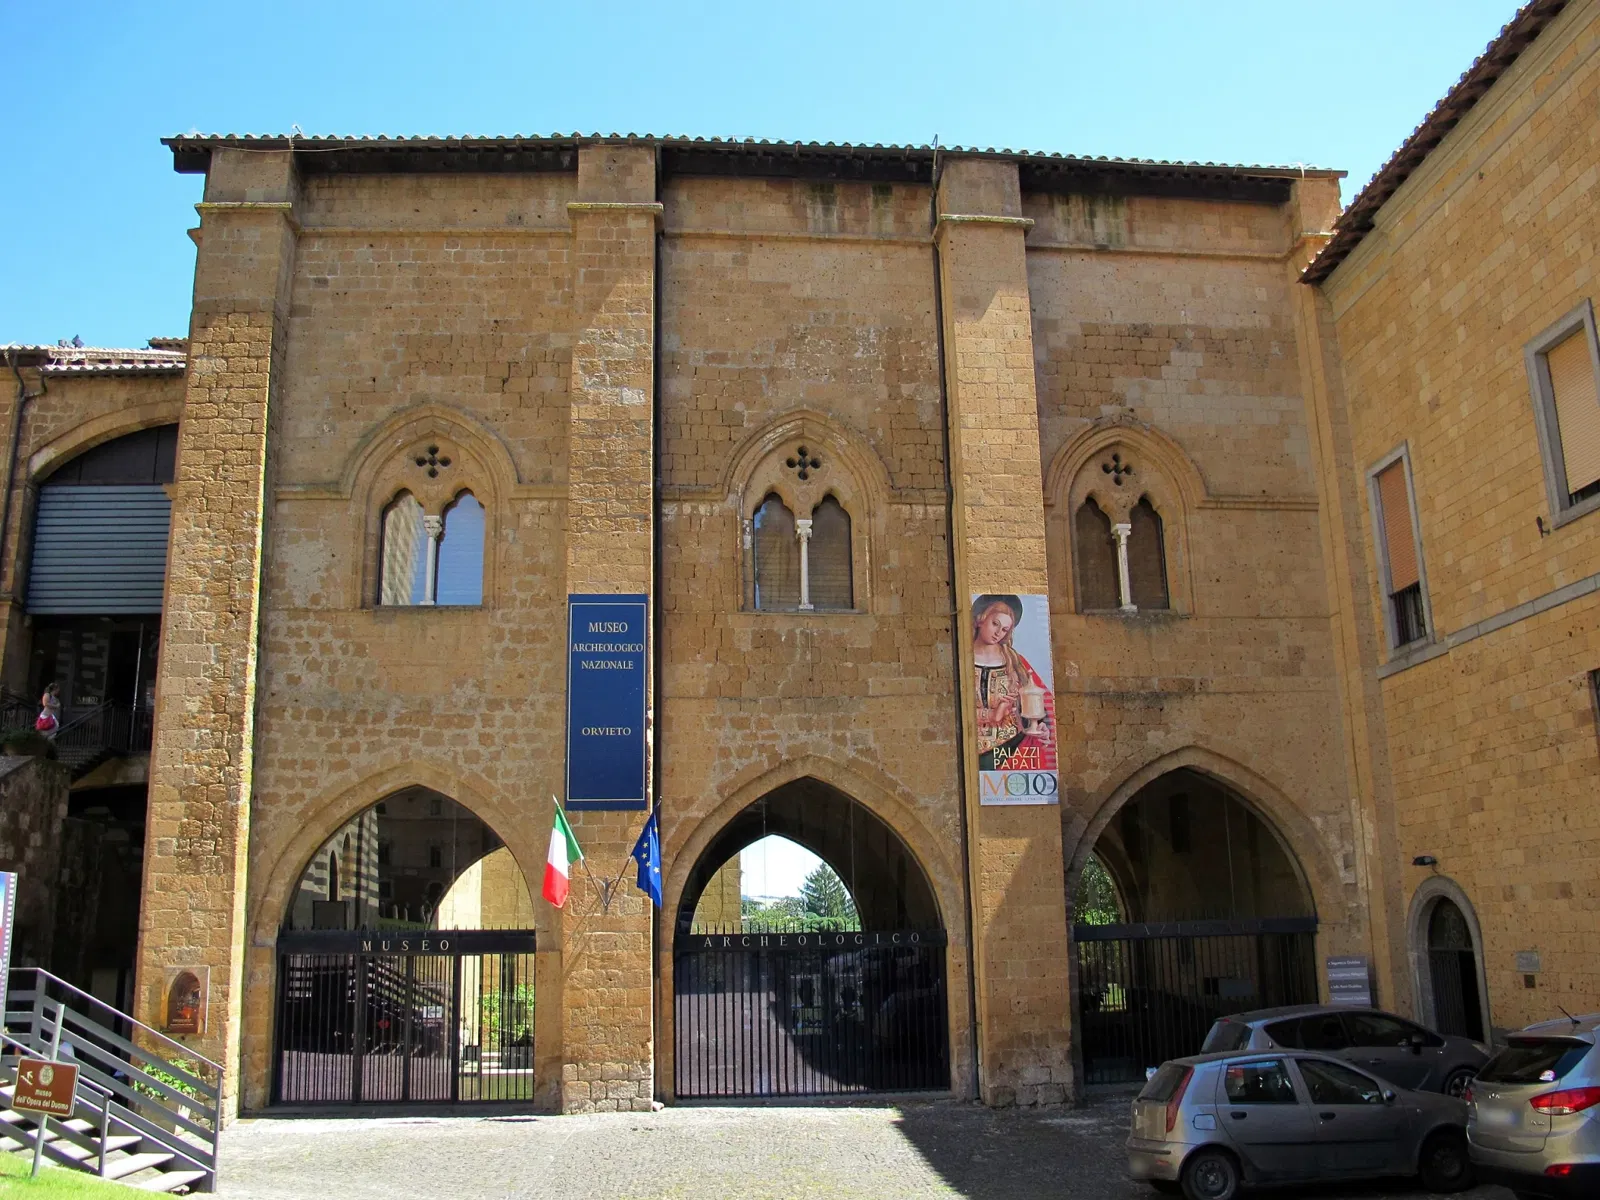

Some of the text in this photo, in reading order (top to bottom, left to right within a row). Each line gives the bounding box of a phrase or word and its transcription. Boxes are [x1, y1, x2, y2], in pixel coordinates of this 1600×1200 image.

[588, 622, 628, 633] MUSEO
[572, 643, 644, 653] ARCHEOLOGICO
[581, 660, 634, 670] NAZIONALE
[582, 727, 631, 736] ORVIETO
[993, 747, 1040, 758] PALAZZI
[993, 759, 1040, 770] PAPALI
[983, 772, 1057, 796] MODO
[704, 932, 920, 947] ARCHEOLOGICO
[362, 940, 449, 952] MUSEO
[35, 1089, 52, 1098] museo
[42, 1099, 50, 1108] del
[51, 1100, 69, 1110] Duomo
